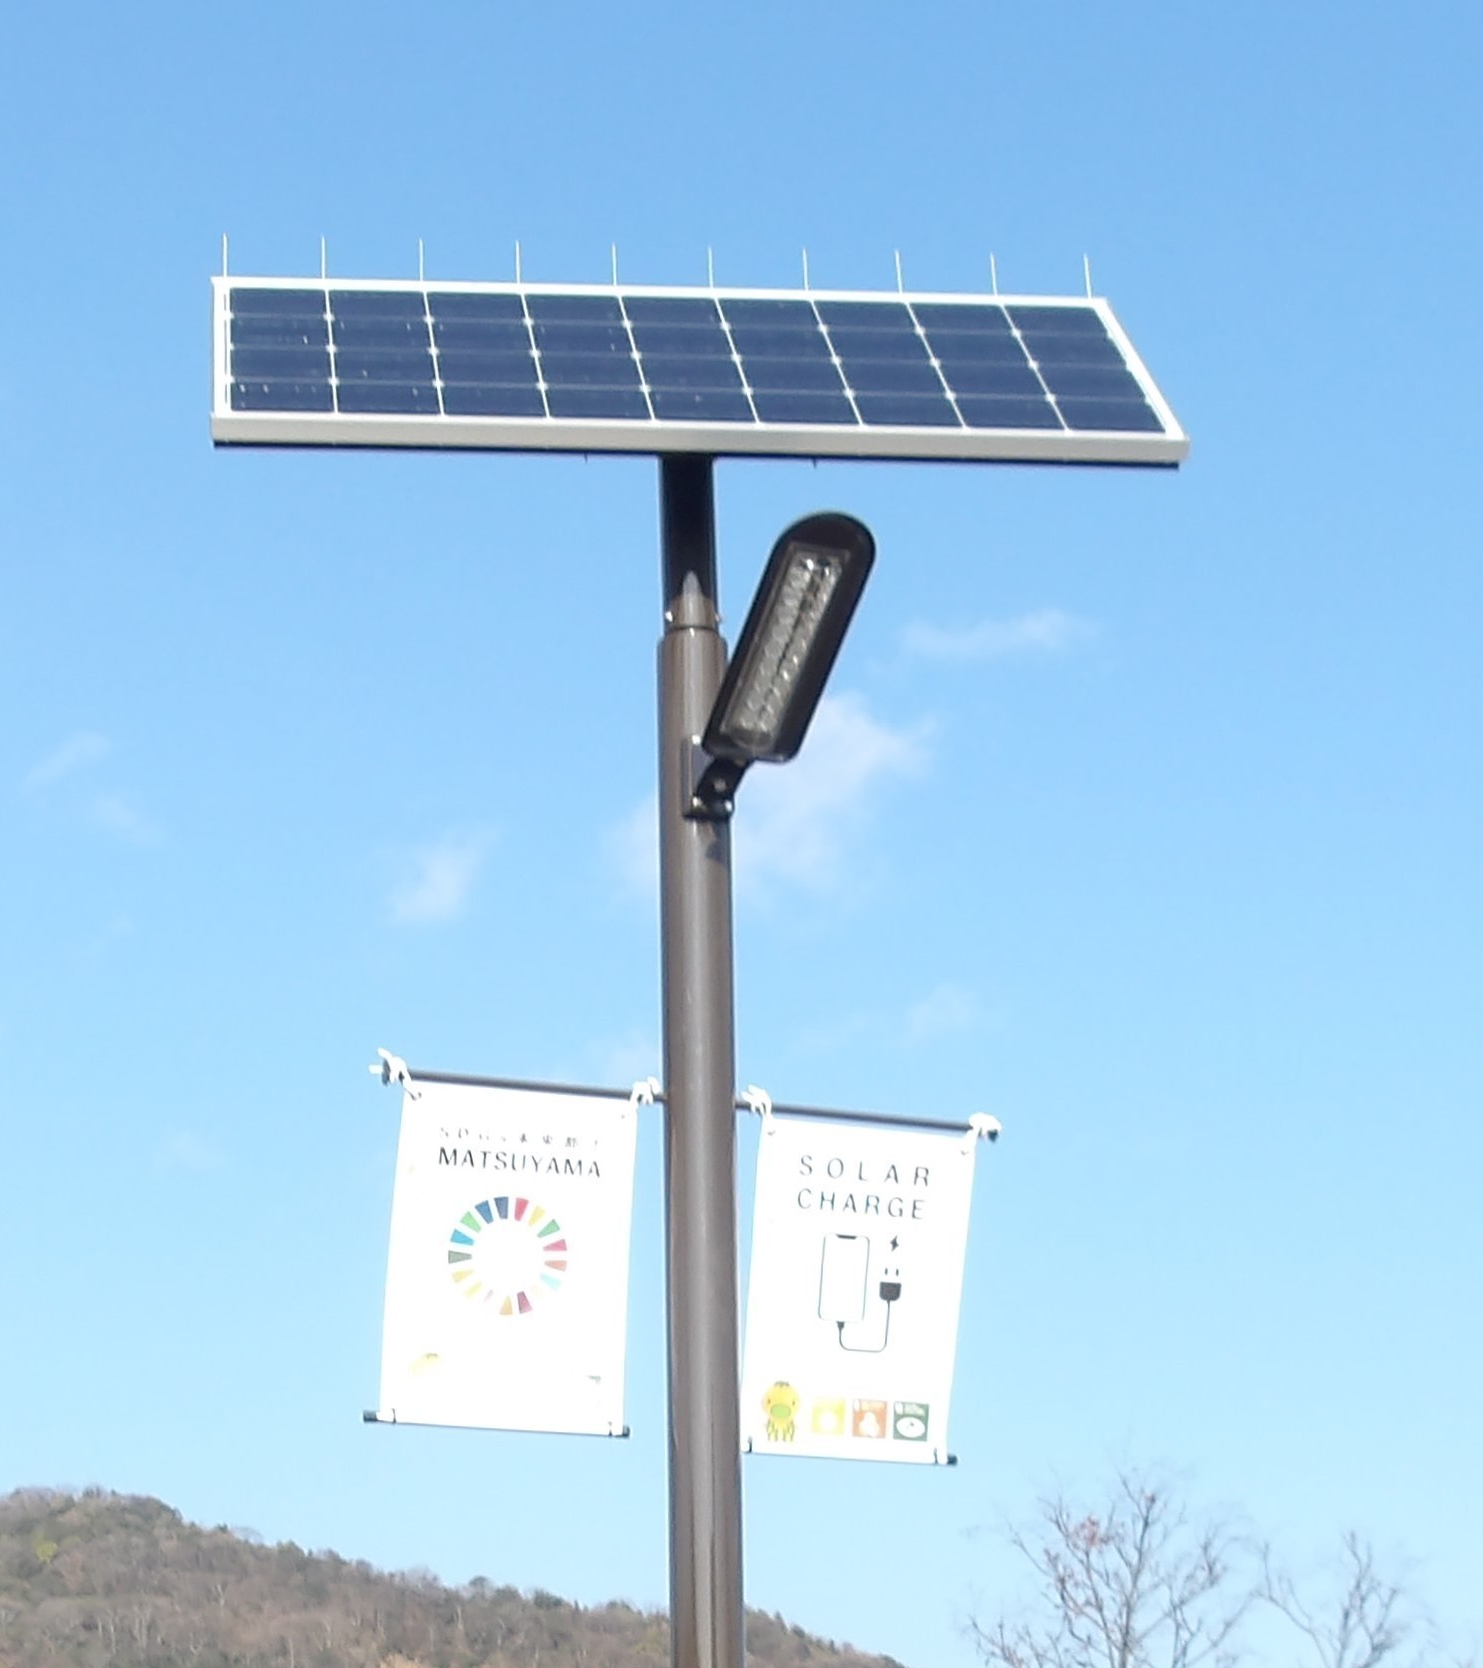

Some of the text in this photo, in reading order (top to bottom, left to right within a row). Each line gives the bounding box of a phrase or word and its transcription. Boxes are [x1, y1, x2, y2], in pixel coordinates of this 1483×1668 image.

[438, 1146, 601, 1178] MATSUYAMA
[798, 1154, 930, 1188] SOLAR
[797, 1187, 927, 1220] CHARGE
